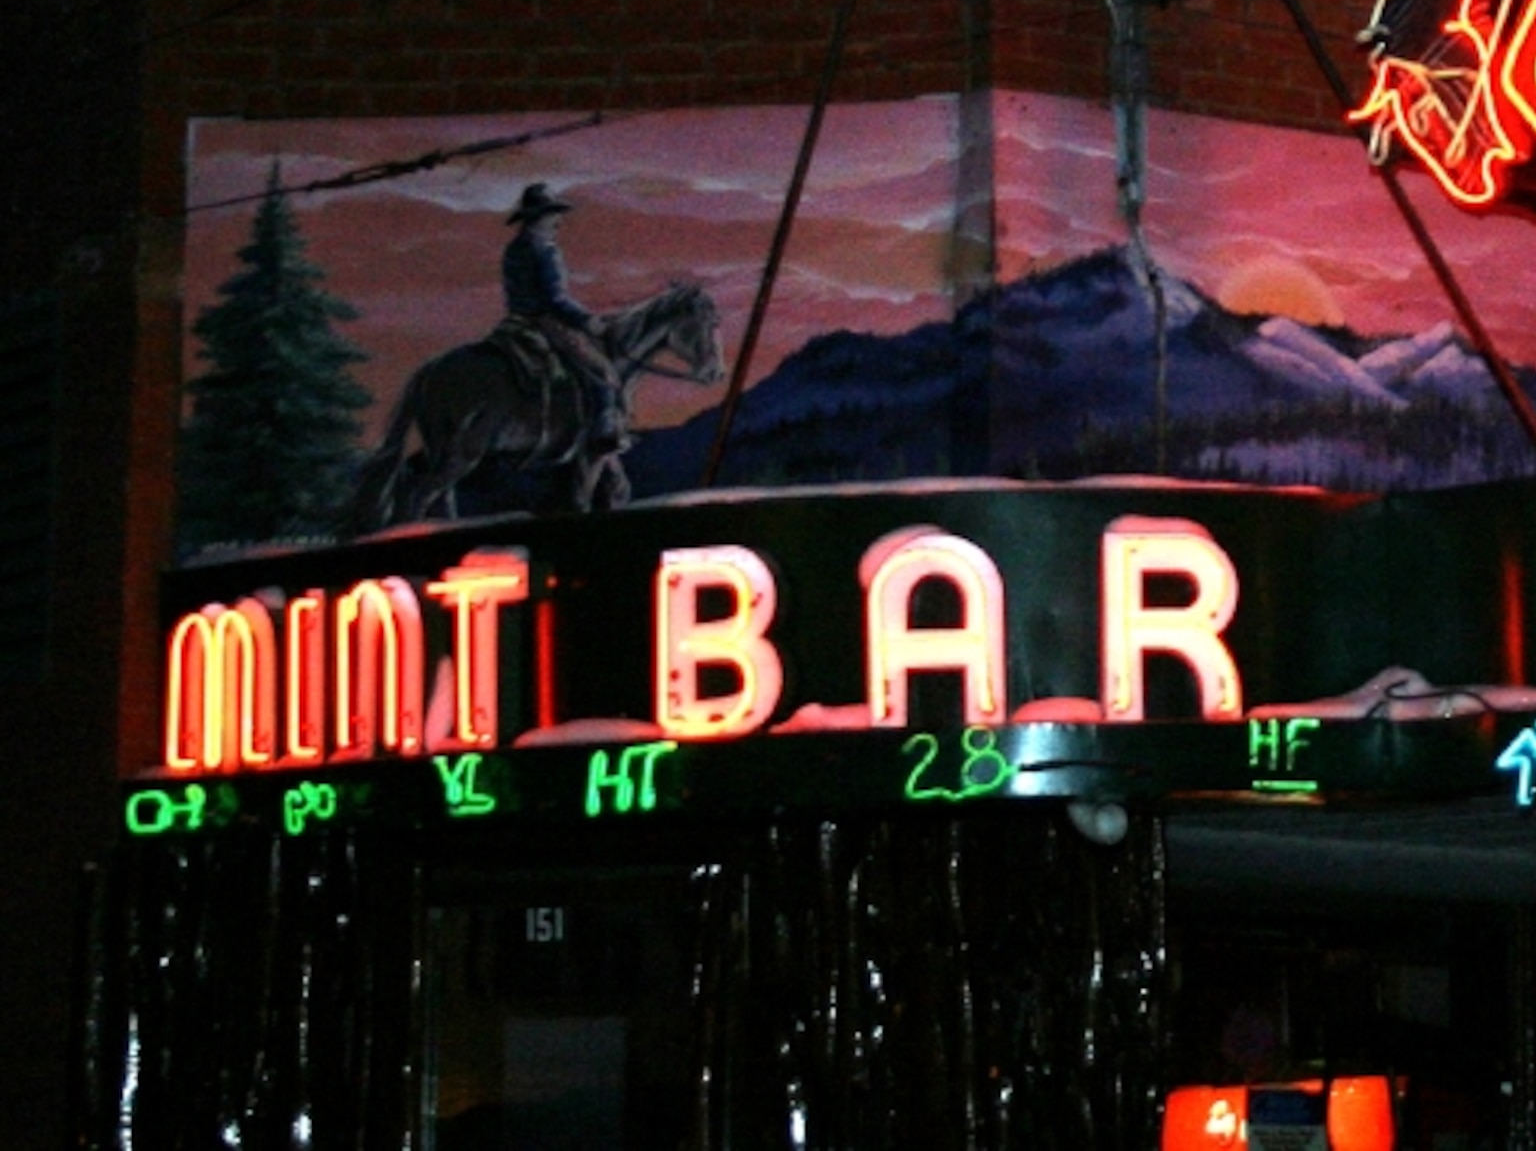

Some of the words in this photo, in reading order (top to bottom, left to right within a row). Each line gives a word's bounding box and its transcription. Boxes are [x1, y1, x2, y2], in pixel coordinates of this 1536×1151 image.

[166, 546, 530, 771] MINT
[653, 517, 1243, 739] BAR
[902, 725, 1018, 801] 28
[526, 907, 564, 942] 151
